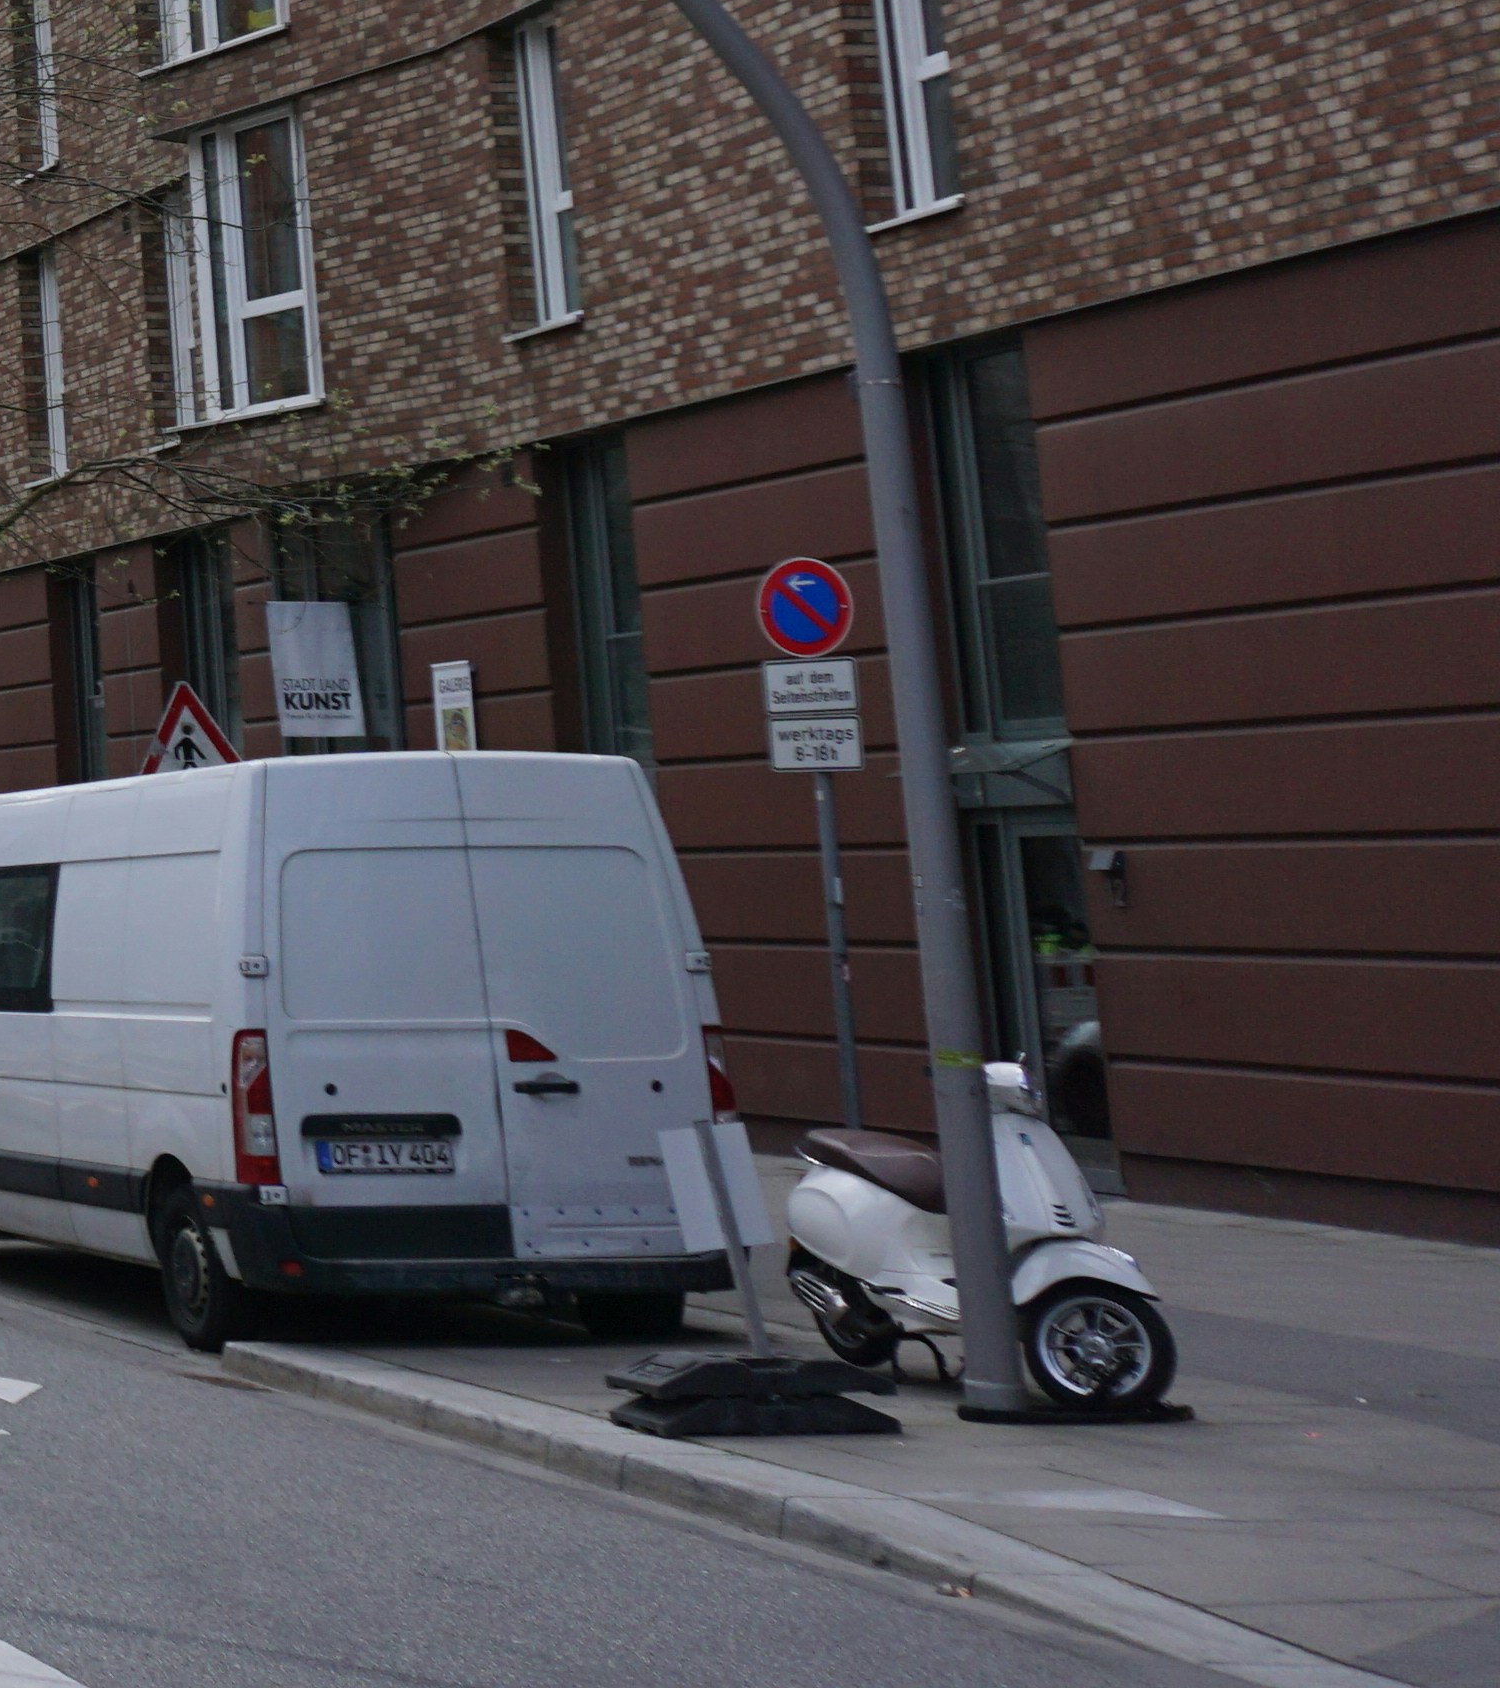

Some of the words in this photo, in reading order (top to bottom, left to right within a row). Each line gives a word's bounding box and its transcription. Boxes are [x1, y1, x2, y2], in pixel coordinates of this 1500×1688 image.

[282, 678, 316, 691] STADT
[319, 678, 350, 691] LAND
[786, 673, 803, 685] auf
[810, 672, 834, 684] dem
[284, 692, 352, 710] KUNST
[772, 688, 852, 705] Seitenstreifen
[779, 726, 854, 745] werktags
[333, 1144, 360, 1165] OF
[409, 1144, 449, 1165] 404
